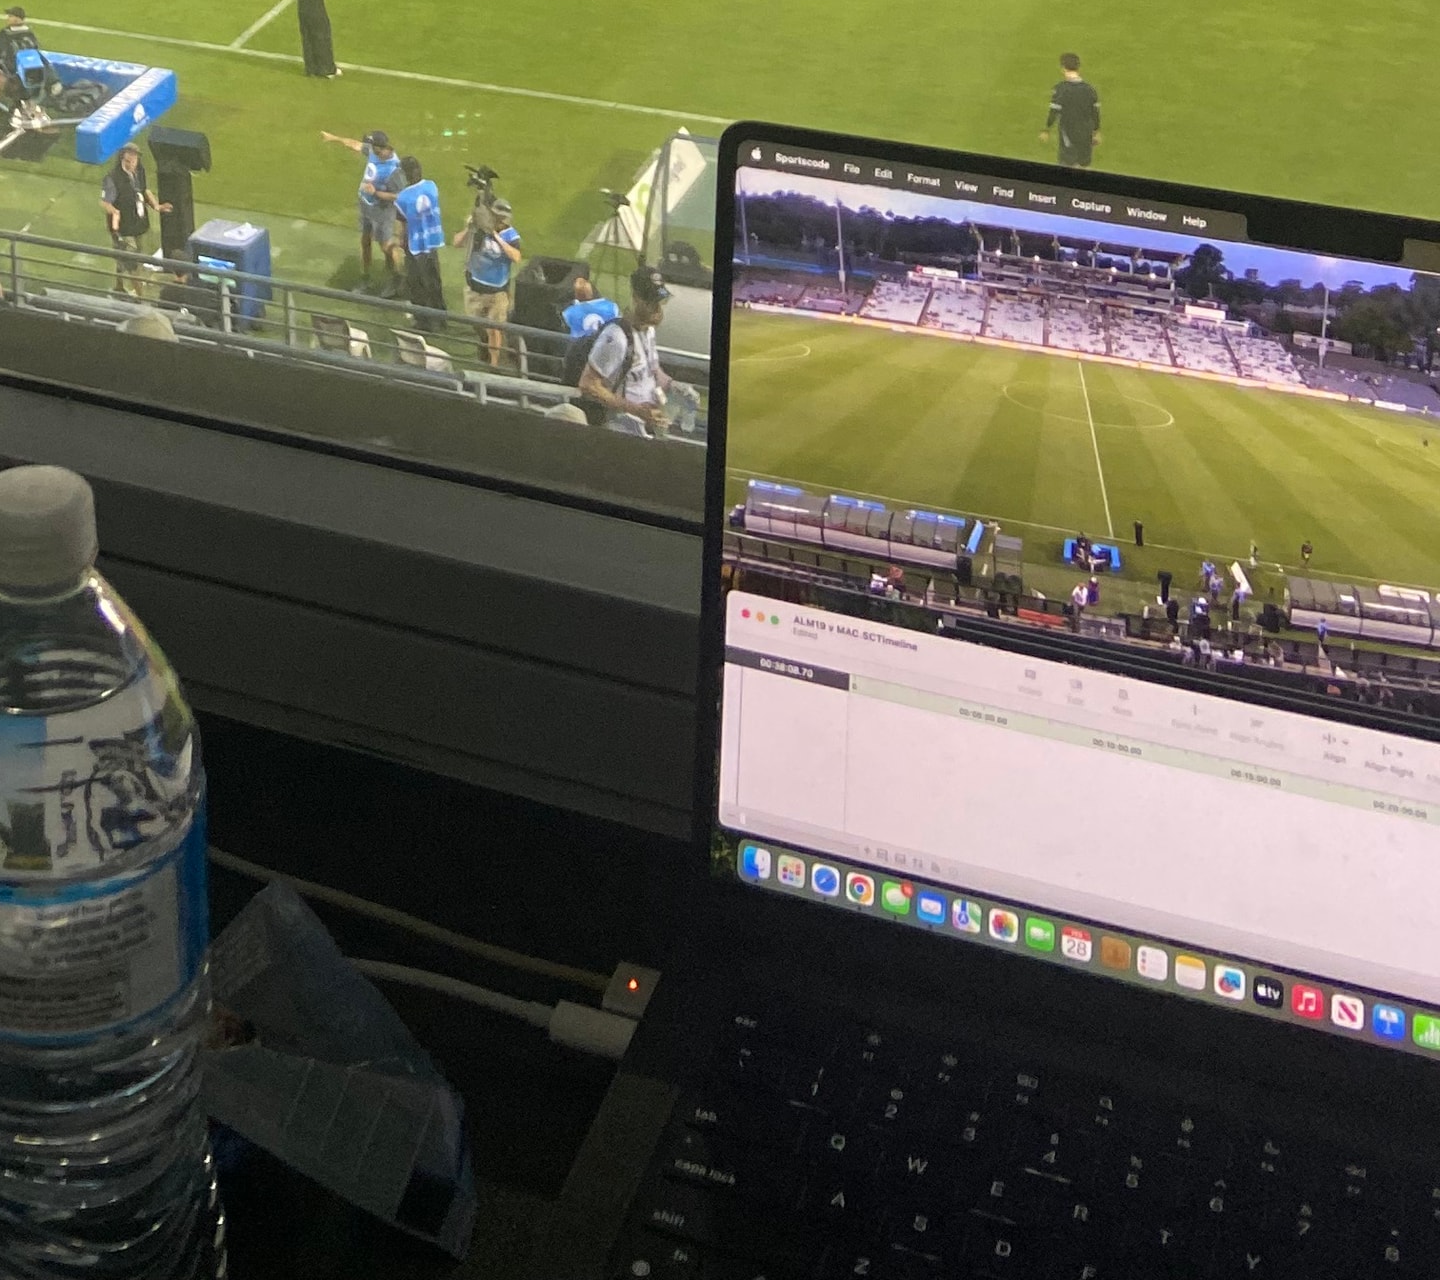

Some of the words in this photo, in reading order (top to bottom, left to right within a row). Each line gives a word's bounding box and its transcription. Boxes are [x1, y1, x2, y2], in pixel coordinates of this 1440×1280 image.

[775, 152, 830, 170] Sportscode
[843, 163, 861, 175] File
[874, 168, 894, 180] Edit
[907, 172, 941, 188] Format
[955, 179, 979, 193] View
[992, 185, 1014, 198] Find
[1028, 192, 1057, 205] Insert
[1071, 198, 1111, 214] Capture
[1126, 206, 1168, 222] Window
[1182, 215, 1208, 229] Help
[1066, 938, 1087, 957] 28
[1266, 986, 1281, 1001] tv
